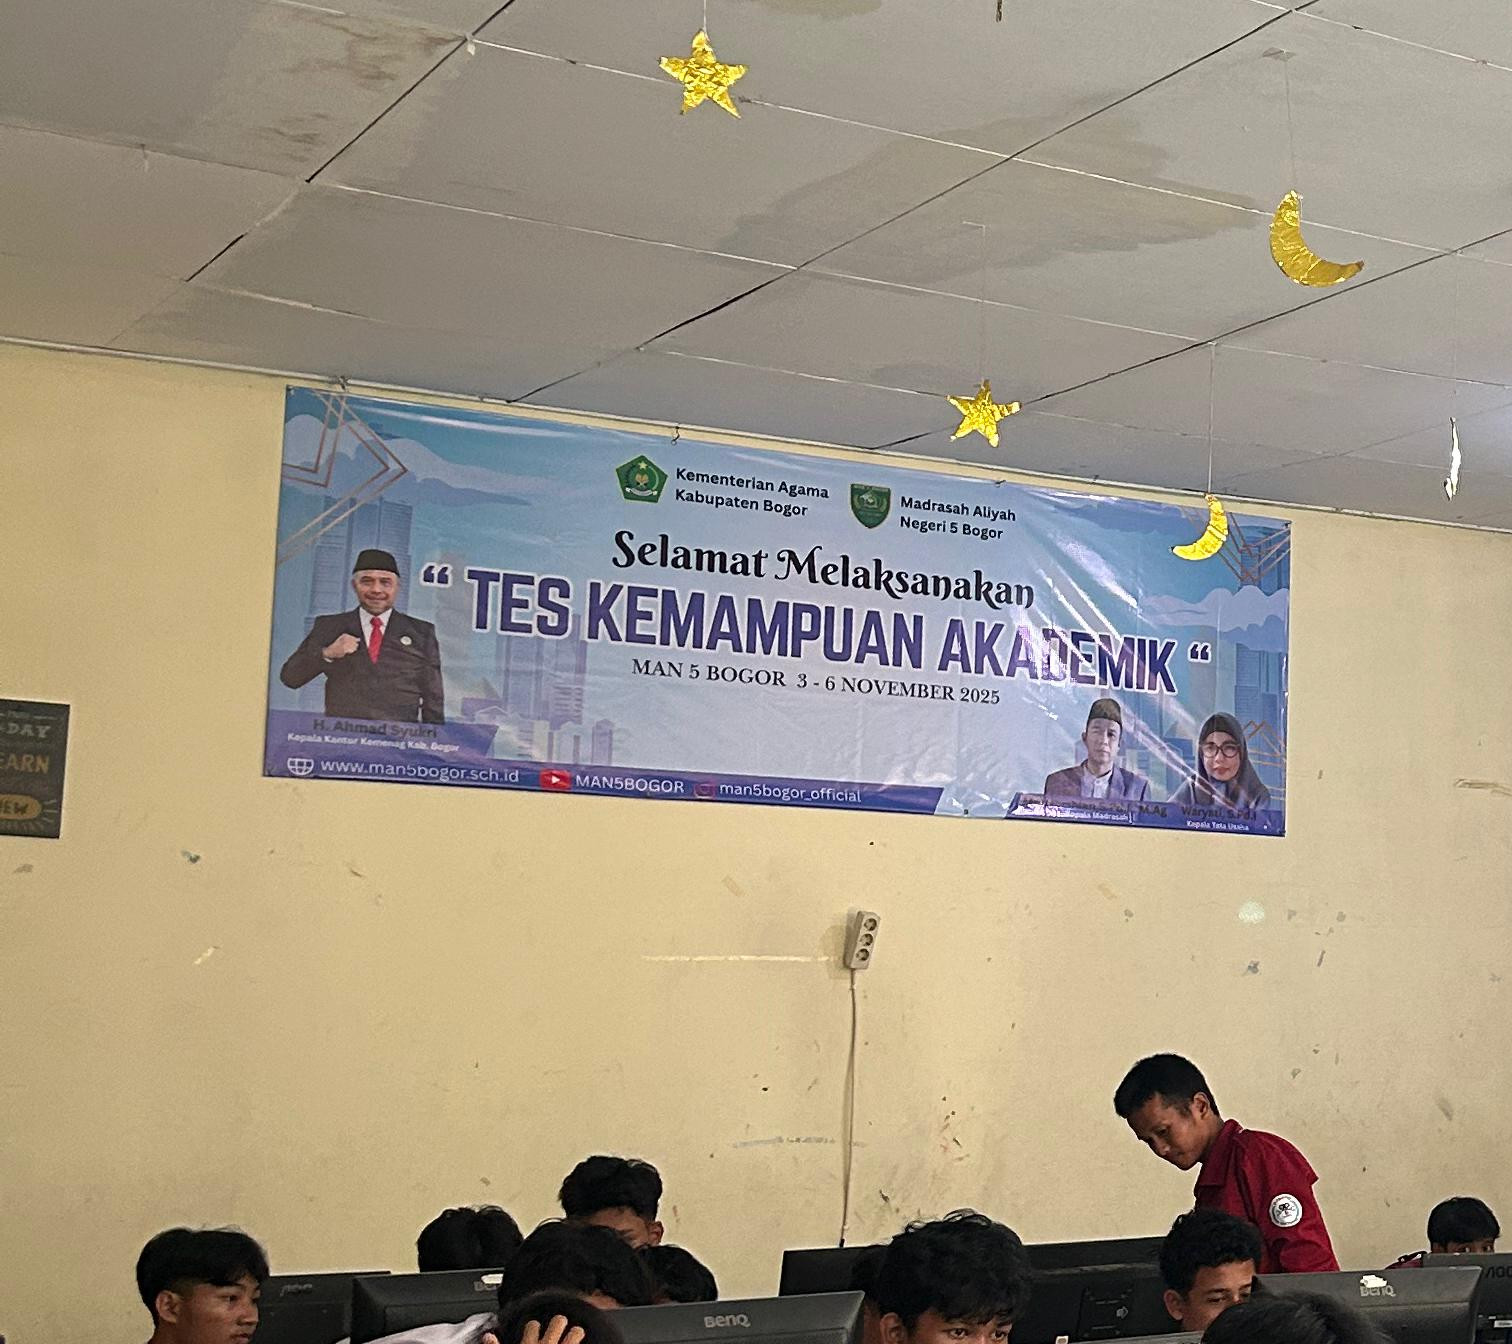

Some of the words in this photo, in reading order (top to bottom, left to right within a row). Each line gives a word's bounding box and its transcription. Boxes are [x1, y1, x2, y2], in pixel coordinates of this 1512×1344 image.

[675, 467, 776, 492] Kementerian
[778, 481, 830, 499] Agama
[674, 489, 760, 513] Kabupaten
[763, 500, 808, 518] Bogor
[900, 496, 970, 517] Madrasah
[972, 505, 1017, 524] Aliyah
[900, 515, 947, 535] Negeri
[949, 521, 958, 534] 5
[962, 523, 1003, 540] Bogor
[611, 529, 769, 580] Selamat
[776, 545, 1035, 610] Melaksanakan
[466, 568, 571, 638] TES
[587, 582, 925, 672] KEMAMPUAN
[937, 616, 1176, 693] AKADEMIK
[631, 658, 684, 680] MAN
[688, 663, 700, 681] 5
[706, 664, 786, 688] BOGOR
[796, 672, 807, 689] 3
[824, 675, 836, 692] 6
[841, 676, 955, 702] NOVEMBER
[960, 687, 1001, 705] 2025
[0, 722, 51, 738] DAY
[334, 721, 387, 735] Ahmad
[320, 759, 519, 783] www.man5bogor.sch.id
[576, 774, 685, 794] MAN5BOGOR
[719, 783, 862, 803] man5bogor_official
[704, 1313, 750, 1329] BenQ
